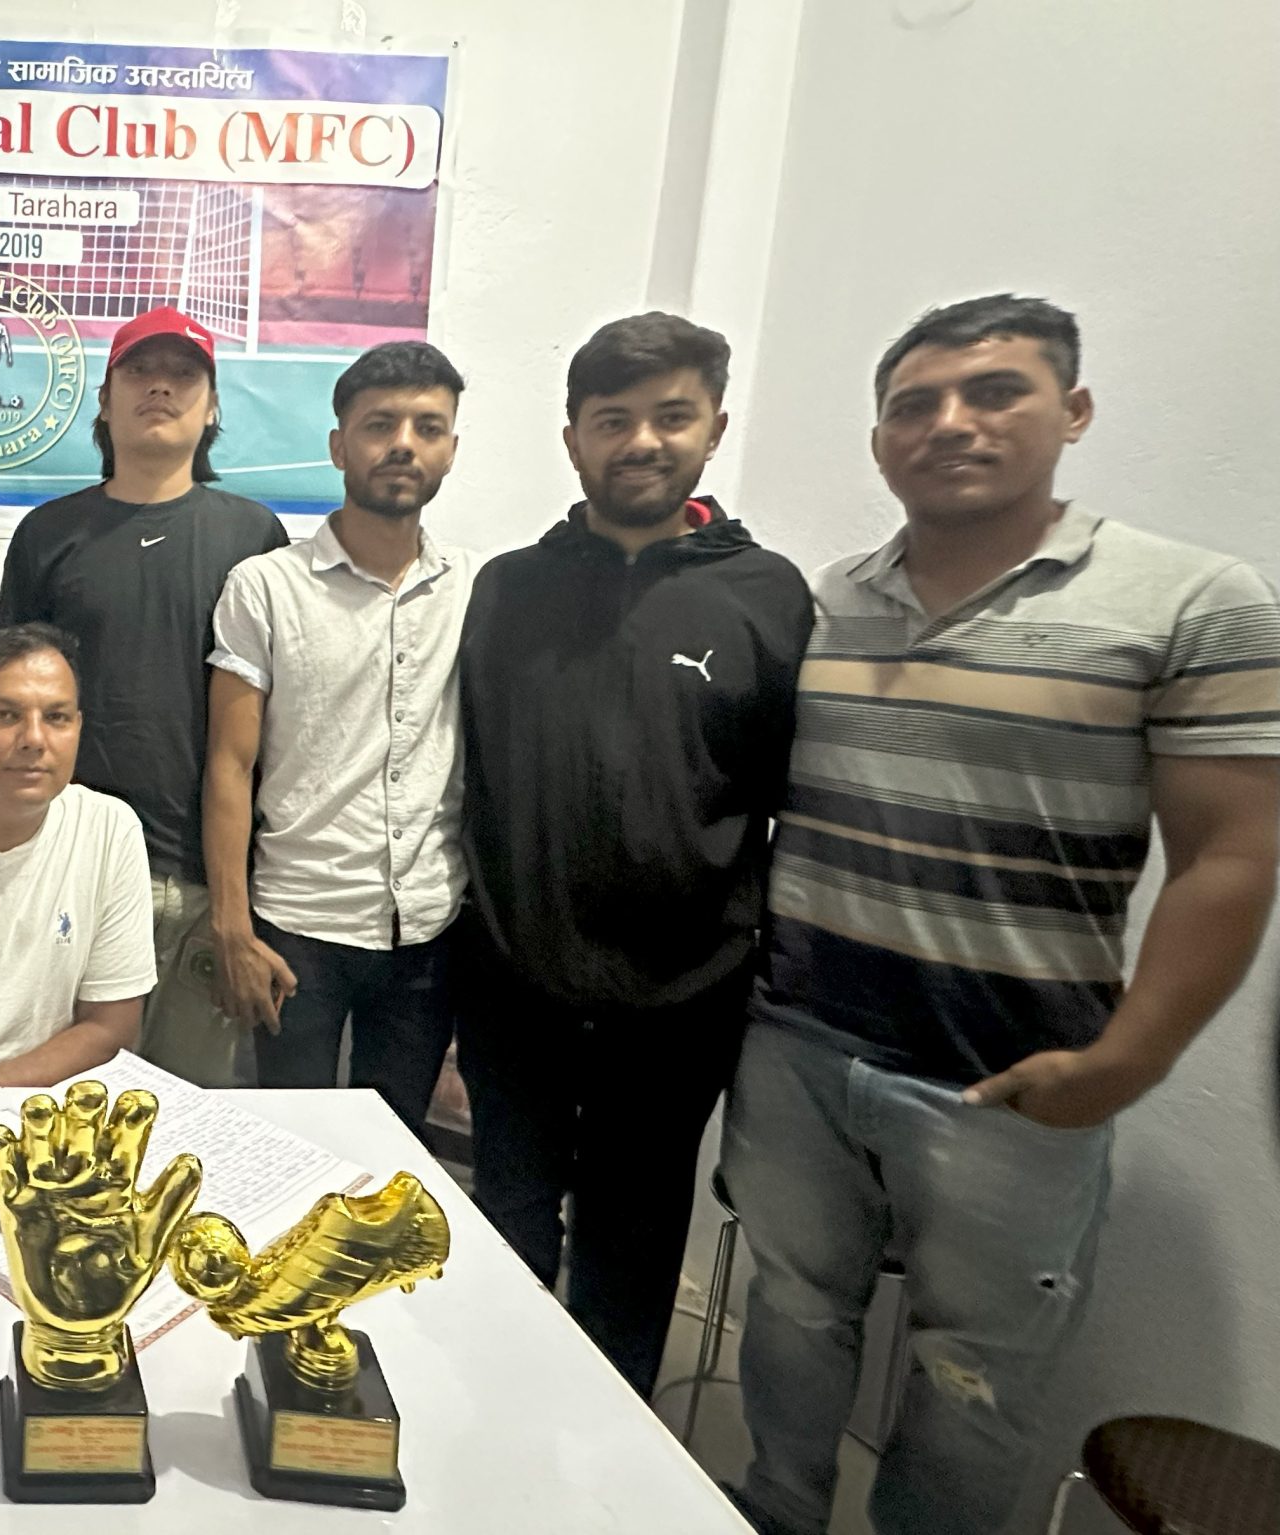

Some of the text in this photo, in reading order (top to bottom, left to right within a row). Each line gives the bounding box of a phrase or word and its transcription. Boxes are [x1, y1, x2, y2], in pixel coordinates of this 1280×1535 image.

[7, 54, 119, 85] सामाजिक
[56, 103, 197, 160] Club
[219, 110, 416, 178] (MFC)
[8, 191, 118, 219] Tarahara
[0, 232, 43, 259] 2019
[10, 284, 58, 330] Club
[49, 333, 78, 411] (MFC)
